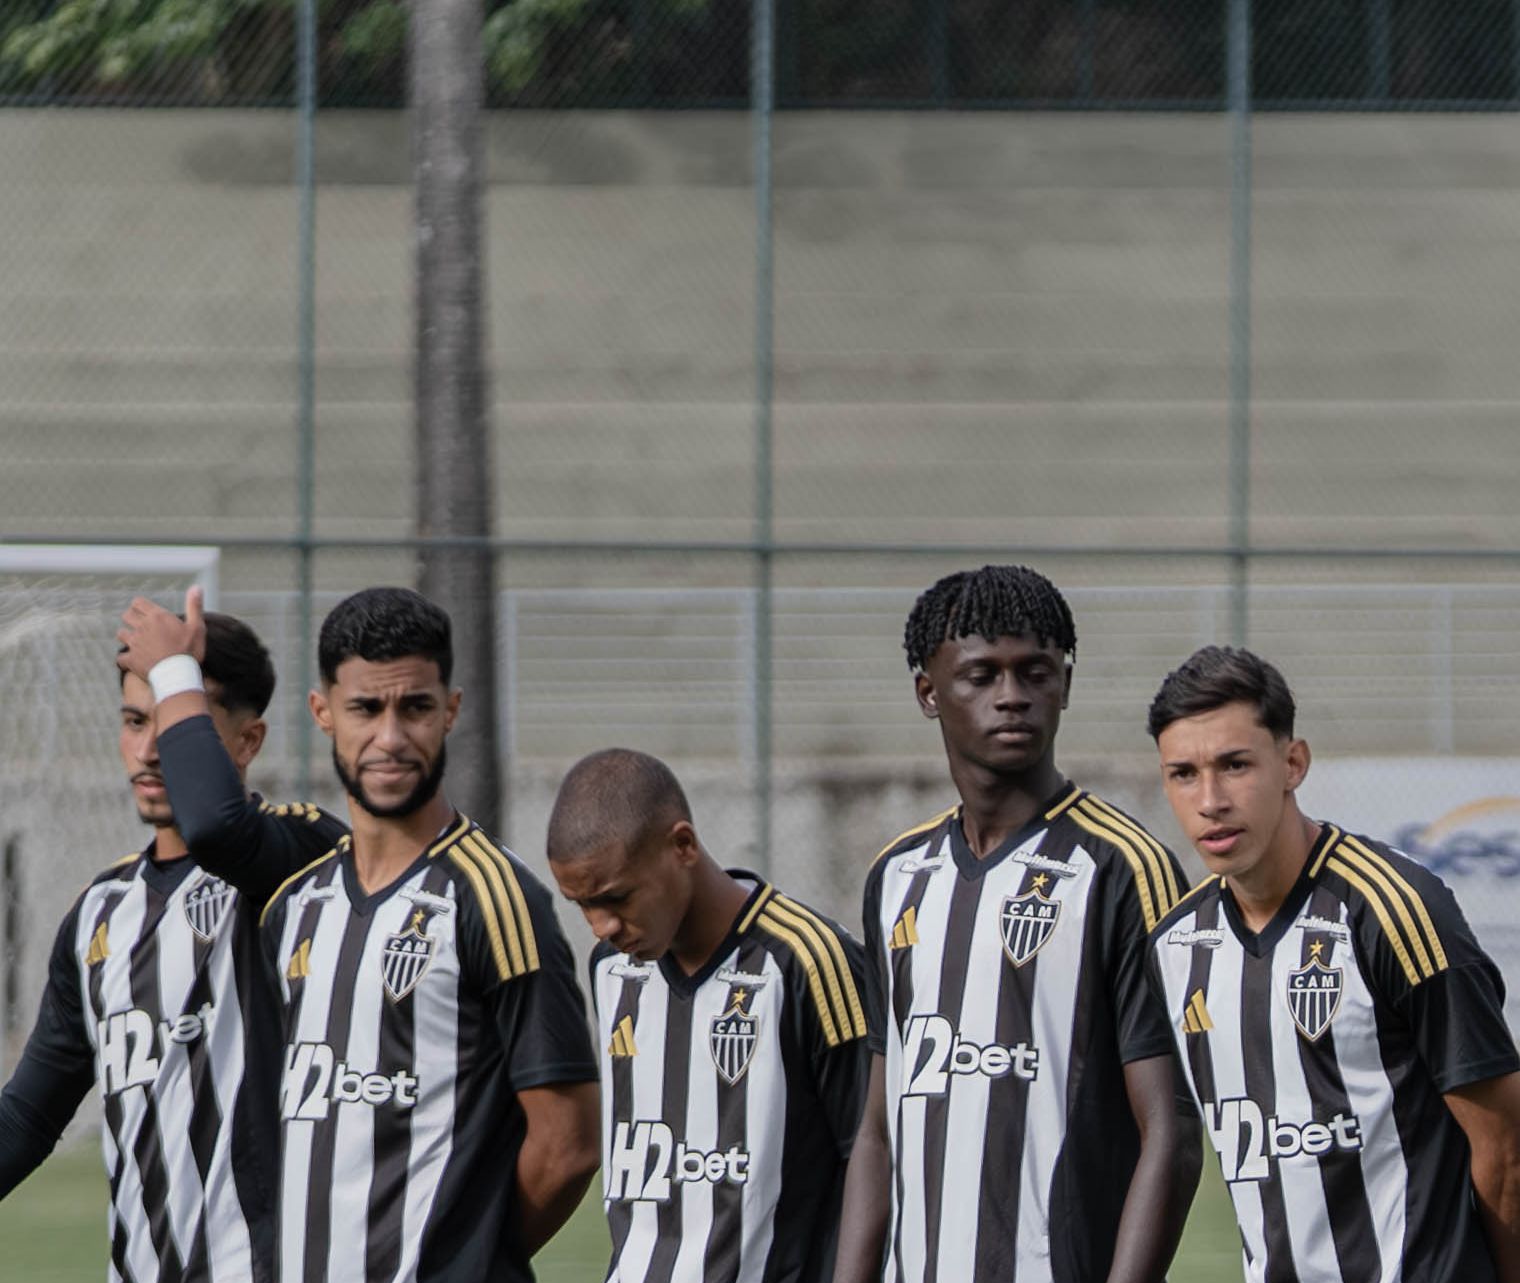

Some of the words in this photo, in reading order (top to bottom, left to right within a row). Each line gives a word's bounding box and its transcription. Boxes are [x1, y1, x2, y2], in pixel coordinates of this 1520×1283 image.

[1009, 902, 1053, 918] CAM
[389, 939, 429, 954] CAM
[1294, 974, 1335, 989] CAM
[715, 1022, 752, 1034] CAM
